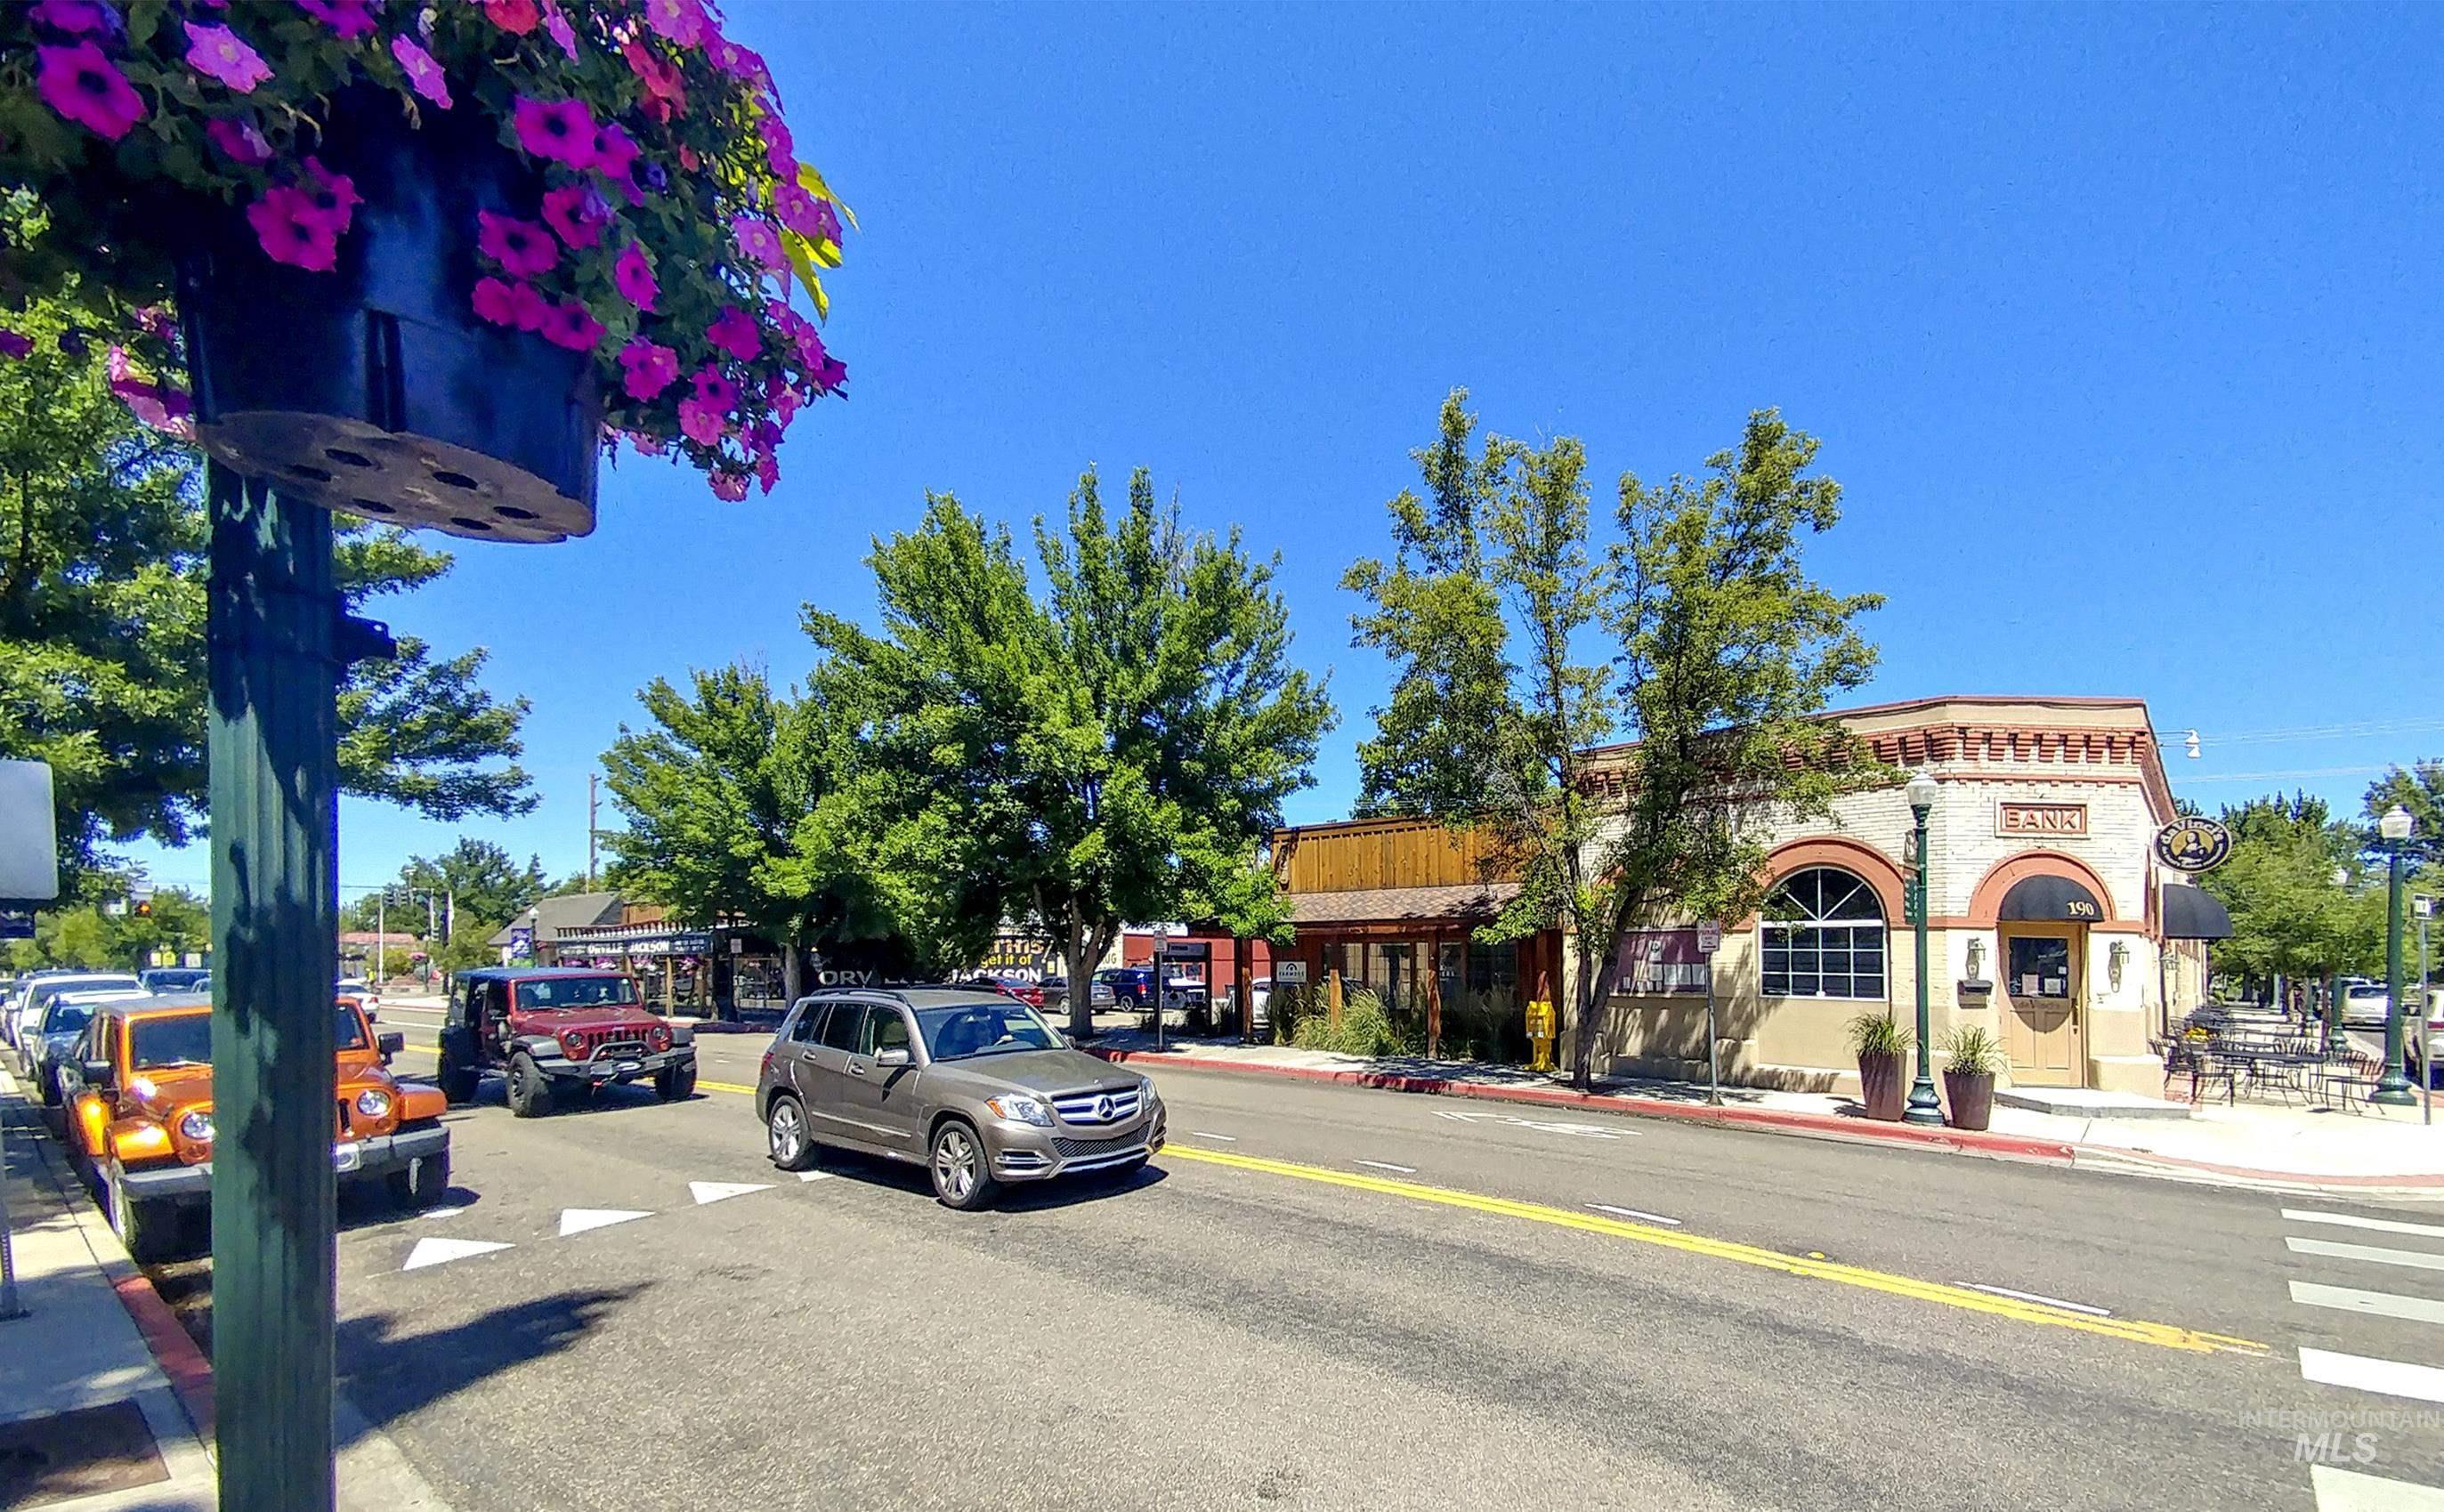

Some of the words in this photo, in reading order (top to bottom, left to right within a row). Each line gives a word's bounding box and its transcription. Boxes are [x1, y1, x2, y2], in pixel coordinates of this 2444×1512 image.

[2005, 808, 2076, 829] BANK
[2067, 901, 2094, 916] 190
[980, 954, 1001, 969] get
[1005, 953, 1015, 966] it
[1018, 953, 1032, 966] of
